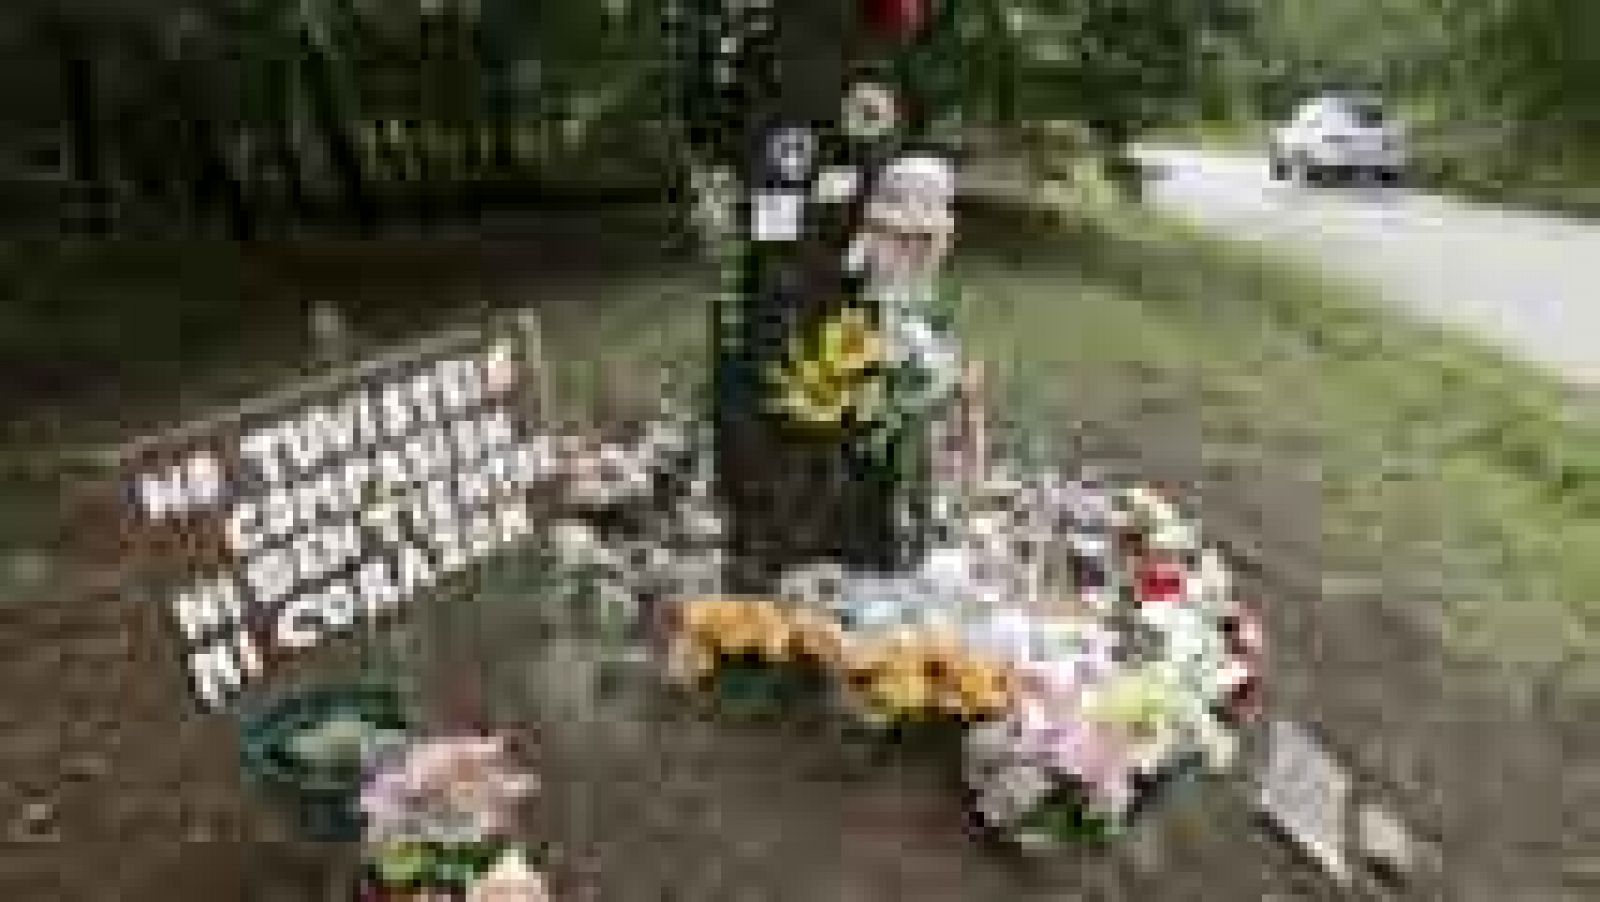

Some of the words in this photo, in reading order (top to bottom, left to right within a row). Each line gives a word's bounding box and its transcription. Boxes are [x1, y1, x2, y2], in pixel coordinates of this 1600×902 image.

[173, 572, 242, 640] NI
[190, 632, 262, 702] NI
[274, 497, 534, 647] CORAZON
